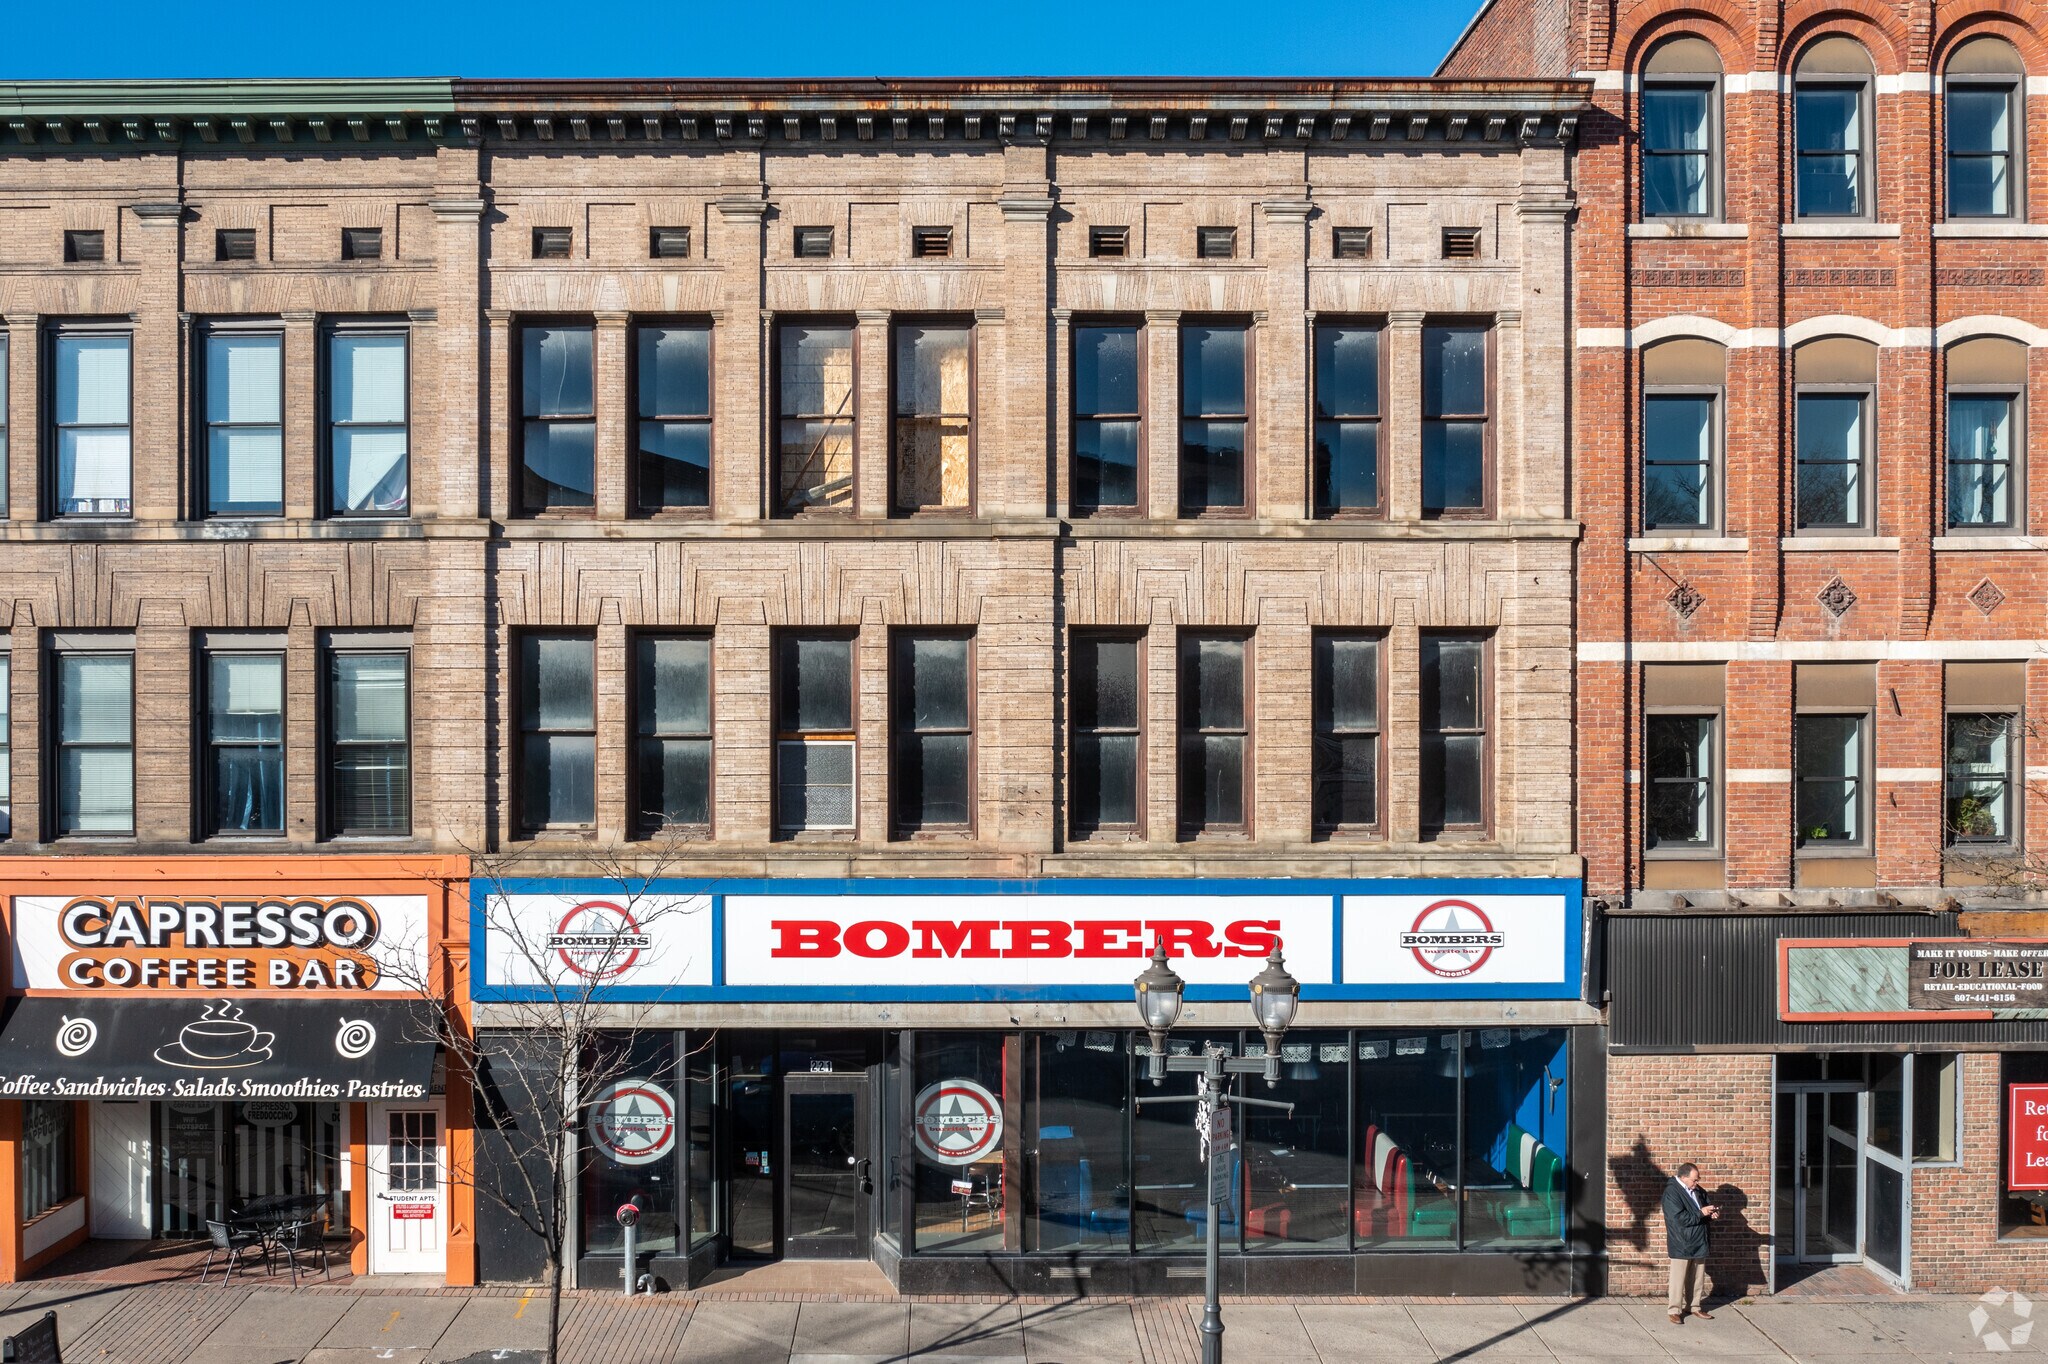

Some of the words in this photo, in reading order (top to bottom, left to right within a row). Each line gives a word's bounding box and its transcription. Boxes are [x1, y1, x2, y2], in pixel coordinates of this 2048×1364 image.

[62, 902, 372, 948] CAPRESSO
[771, 919, 1283, 958] BOMBERS
[1402, 935, 1502, 944] BOMBERS
[1917, 949, 1943, 958] MAKE
[1945, 949, 1955, 958] IT
[1993, 949, 2018, 958] MAKE
[68, 957, 252, 987] COFFEE
[268, 957, 362, 987] BAR
[1434, 969, 1471, 978] oneonta
[1928, 961, 1972, 979] FOR
[1978, 961, 2044, 979] LEASE
[1954, 993, 2016, 1002] 607-441-6156
[811, 1061, 833, 1072] 221
[53, 1076, 166, 1096] Sandwiches
[172, 1076, 236, 1097] Salads
[239, 1076, 340, 1098] Smoothies
[347, 1079, 423, 1098] Pastries
[251, 1102, 290, 1111] ESPRESSO
[2024, 1100, 2048, 1116] Re
[247, 1111, 293, 1120] FREDDOCCINO
[589, 1115, 675, 1125] BOMBERS
[915, 1114, 1000, 1125] BOMBERS
[1216, 1118, 1225, 1128] NO
